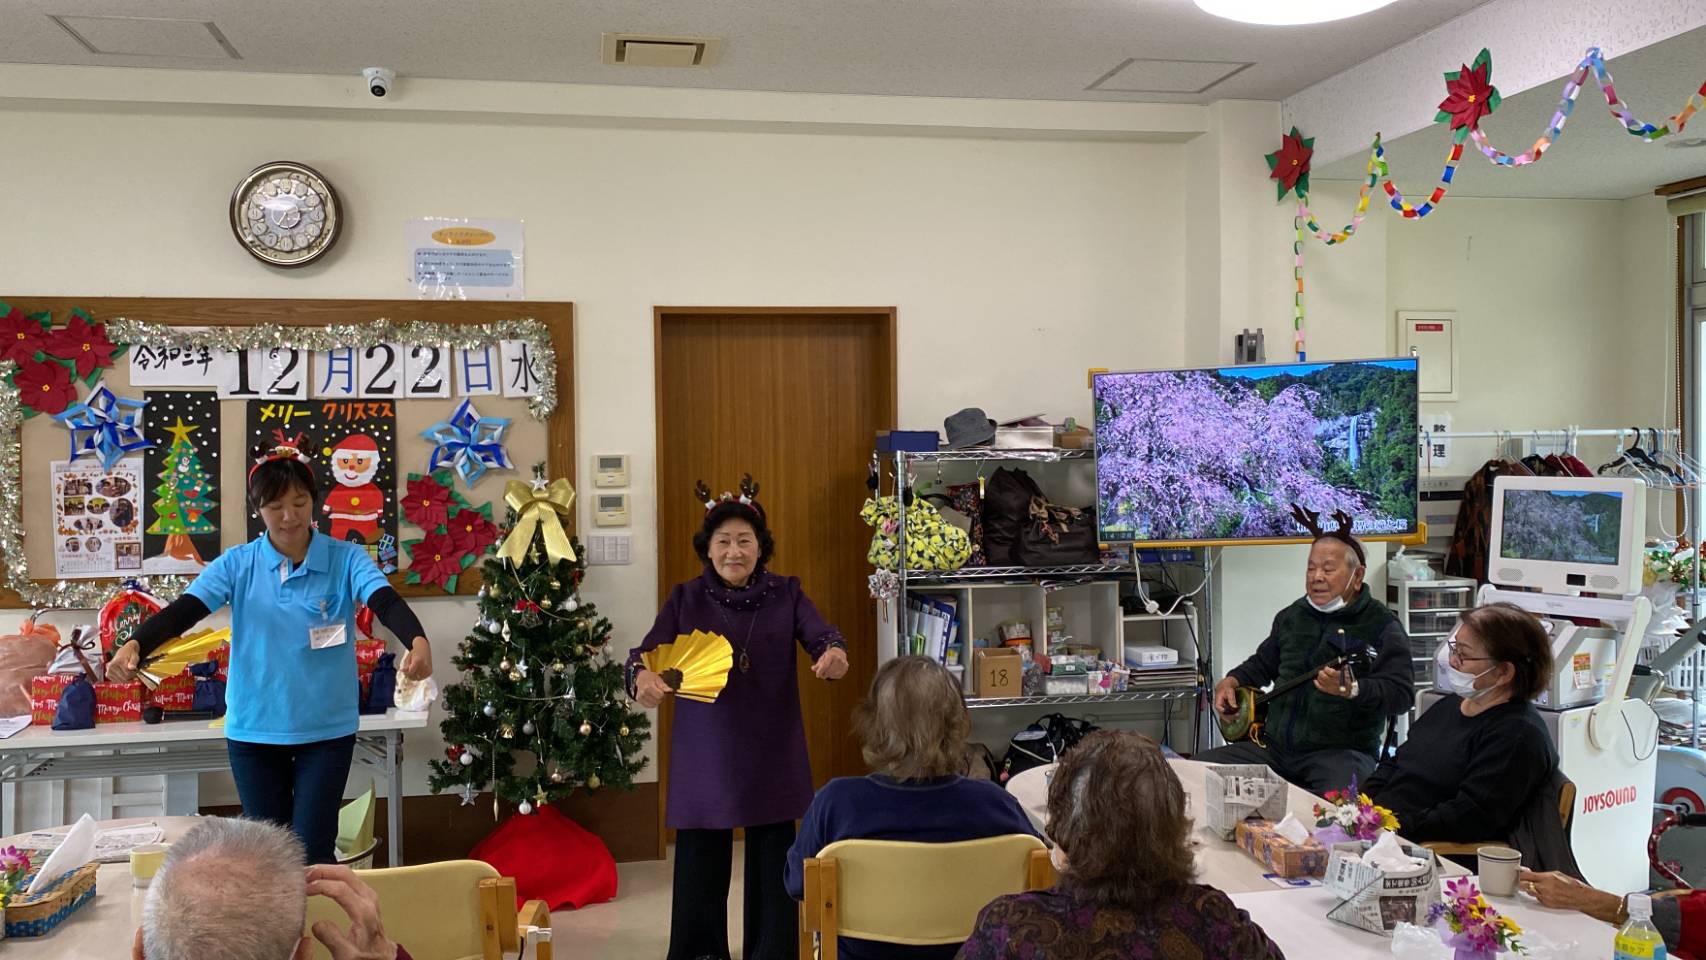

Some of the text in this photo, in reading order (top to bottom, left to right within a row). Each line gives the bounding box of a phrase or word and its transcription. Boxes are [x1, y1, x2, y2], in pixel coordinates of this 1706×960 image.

[260, 402, 395, 425] メリー クリスマス
[990, 669, 1009, 688] 18
[1583, 785, 1637, 815] JOYSOUND
